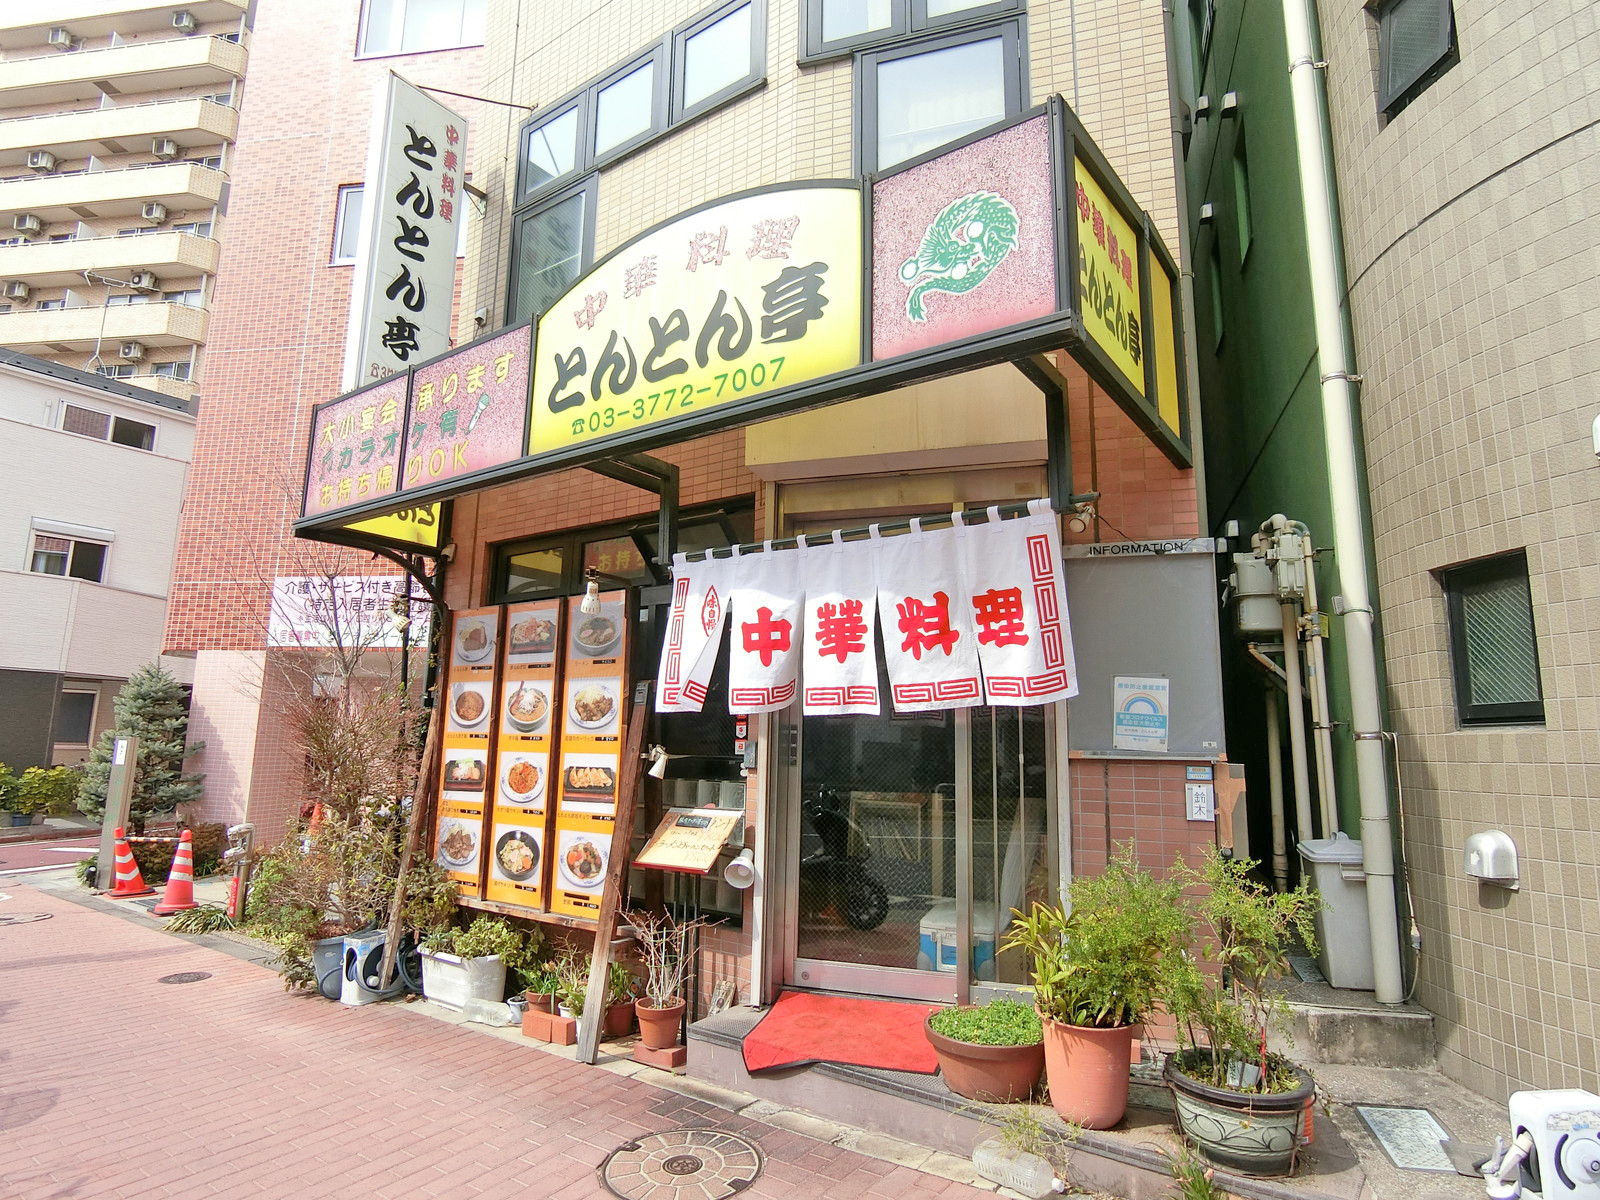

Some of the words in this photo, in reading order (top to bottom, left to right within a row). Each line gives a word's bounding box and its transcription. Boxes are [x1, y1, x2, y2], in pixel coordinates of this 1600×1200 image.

[440, 124, 459, 223] 中華料理
[385, 124, 437, 362] とんとん亭
[574, 214, 801, 330] 中華料理
[1075, 181, 1133, 293] 中華料理
[548, 261, 830, 414] とんとん亭
[588, 356, 786, 433] 03-3772-7007
[1089, 542, 1184, 555] INFORMATION
[741, 586, 1030, 667] 中華料理
[1194, 791, 1206, 816] 鈴木
